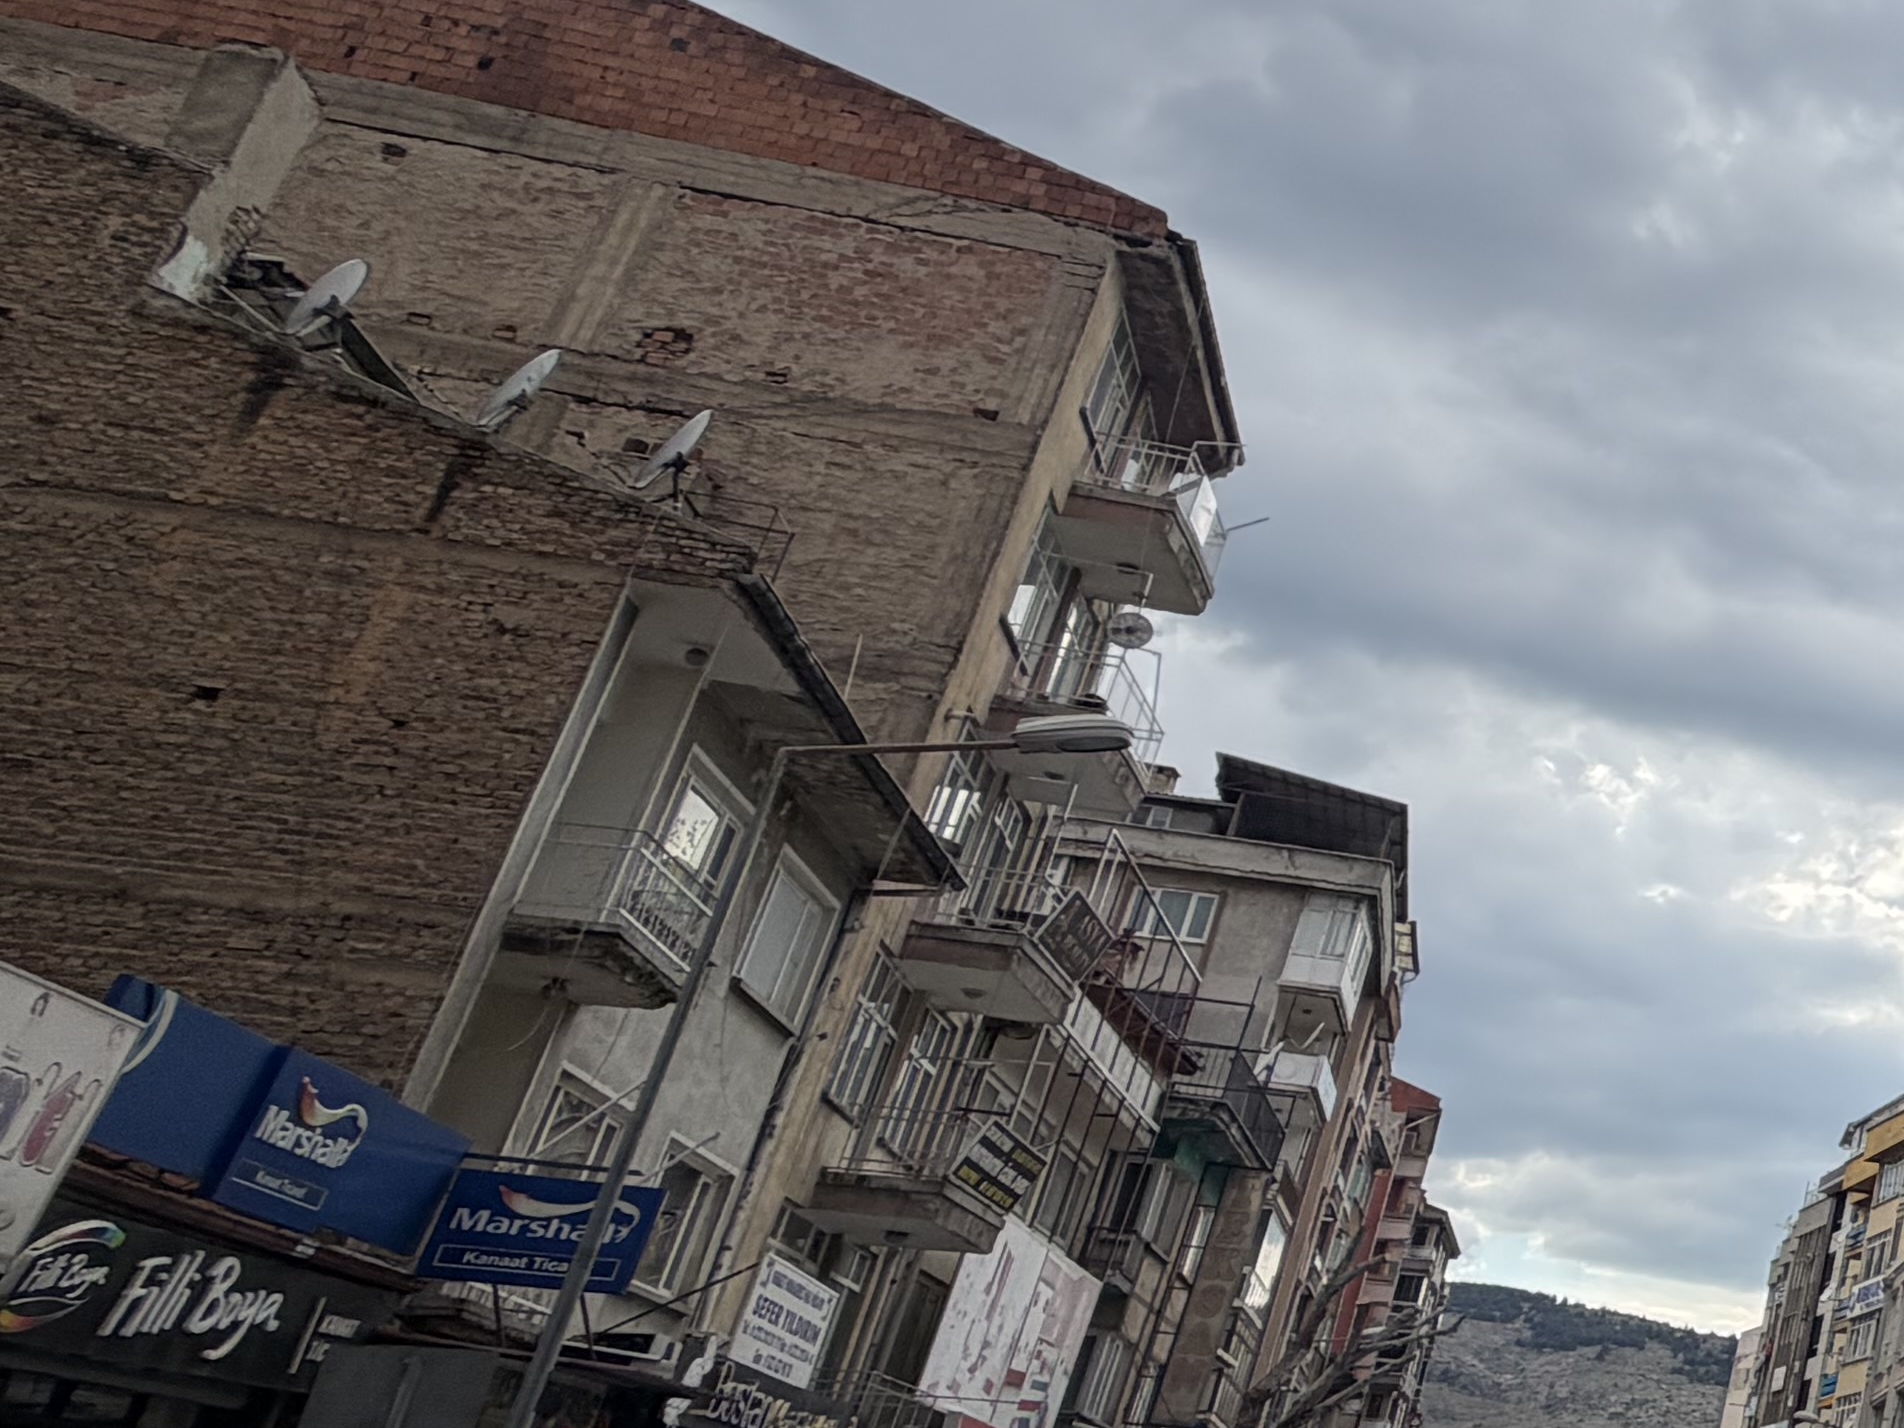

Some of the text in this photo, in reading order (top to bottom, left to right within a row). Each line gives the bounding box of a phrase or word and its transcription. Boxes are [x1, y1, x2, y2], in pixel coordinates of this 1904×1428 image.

[461, 1250, 528, 1270] Kanaat
[96, 1249, 285, 1361] Filli Boya
